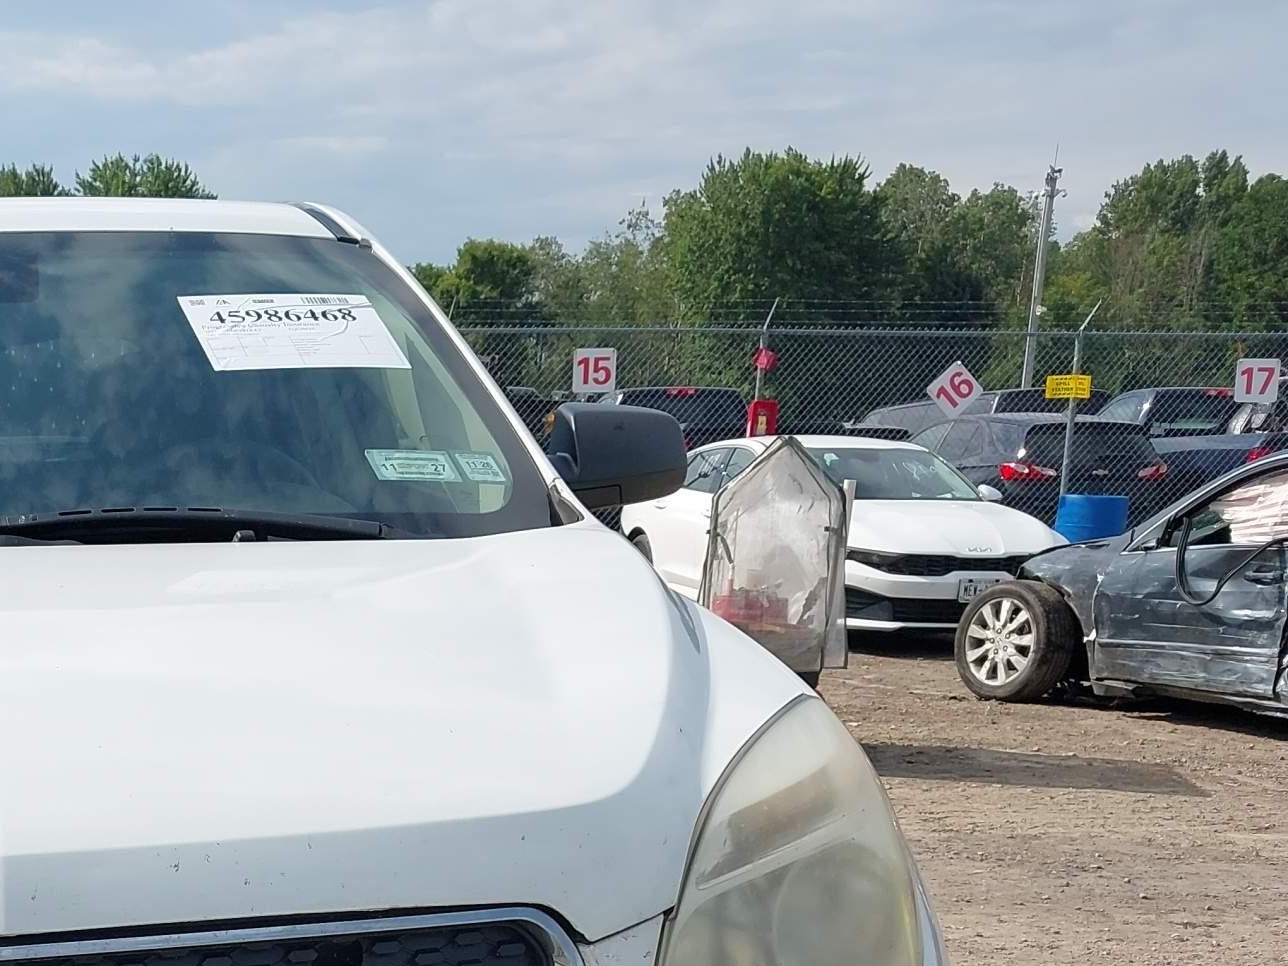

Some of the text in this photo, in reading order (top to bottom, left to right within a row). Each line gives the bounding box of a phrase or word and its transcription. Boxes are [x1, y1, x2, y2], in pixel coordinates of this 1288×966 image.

[209, 308, 357, 324] 45986468
[577, 356, 611, 385] 15
[1241, 367, 1275, 395] 17
[936, 371, 974, 408] 16
